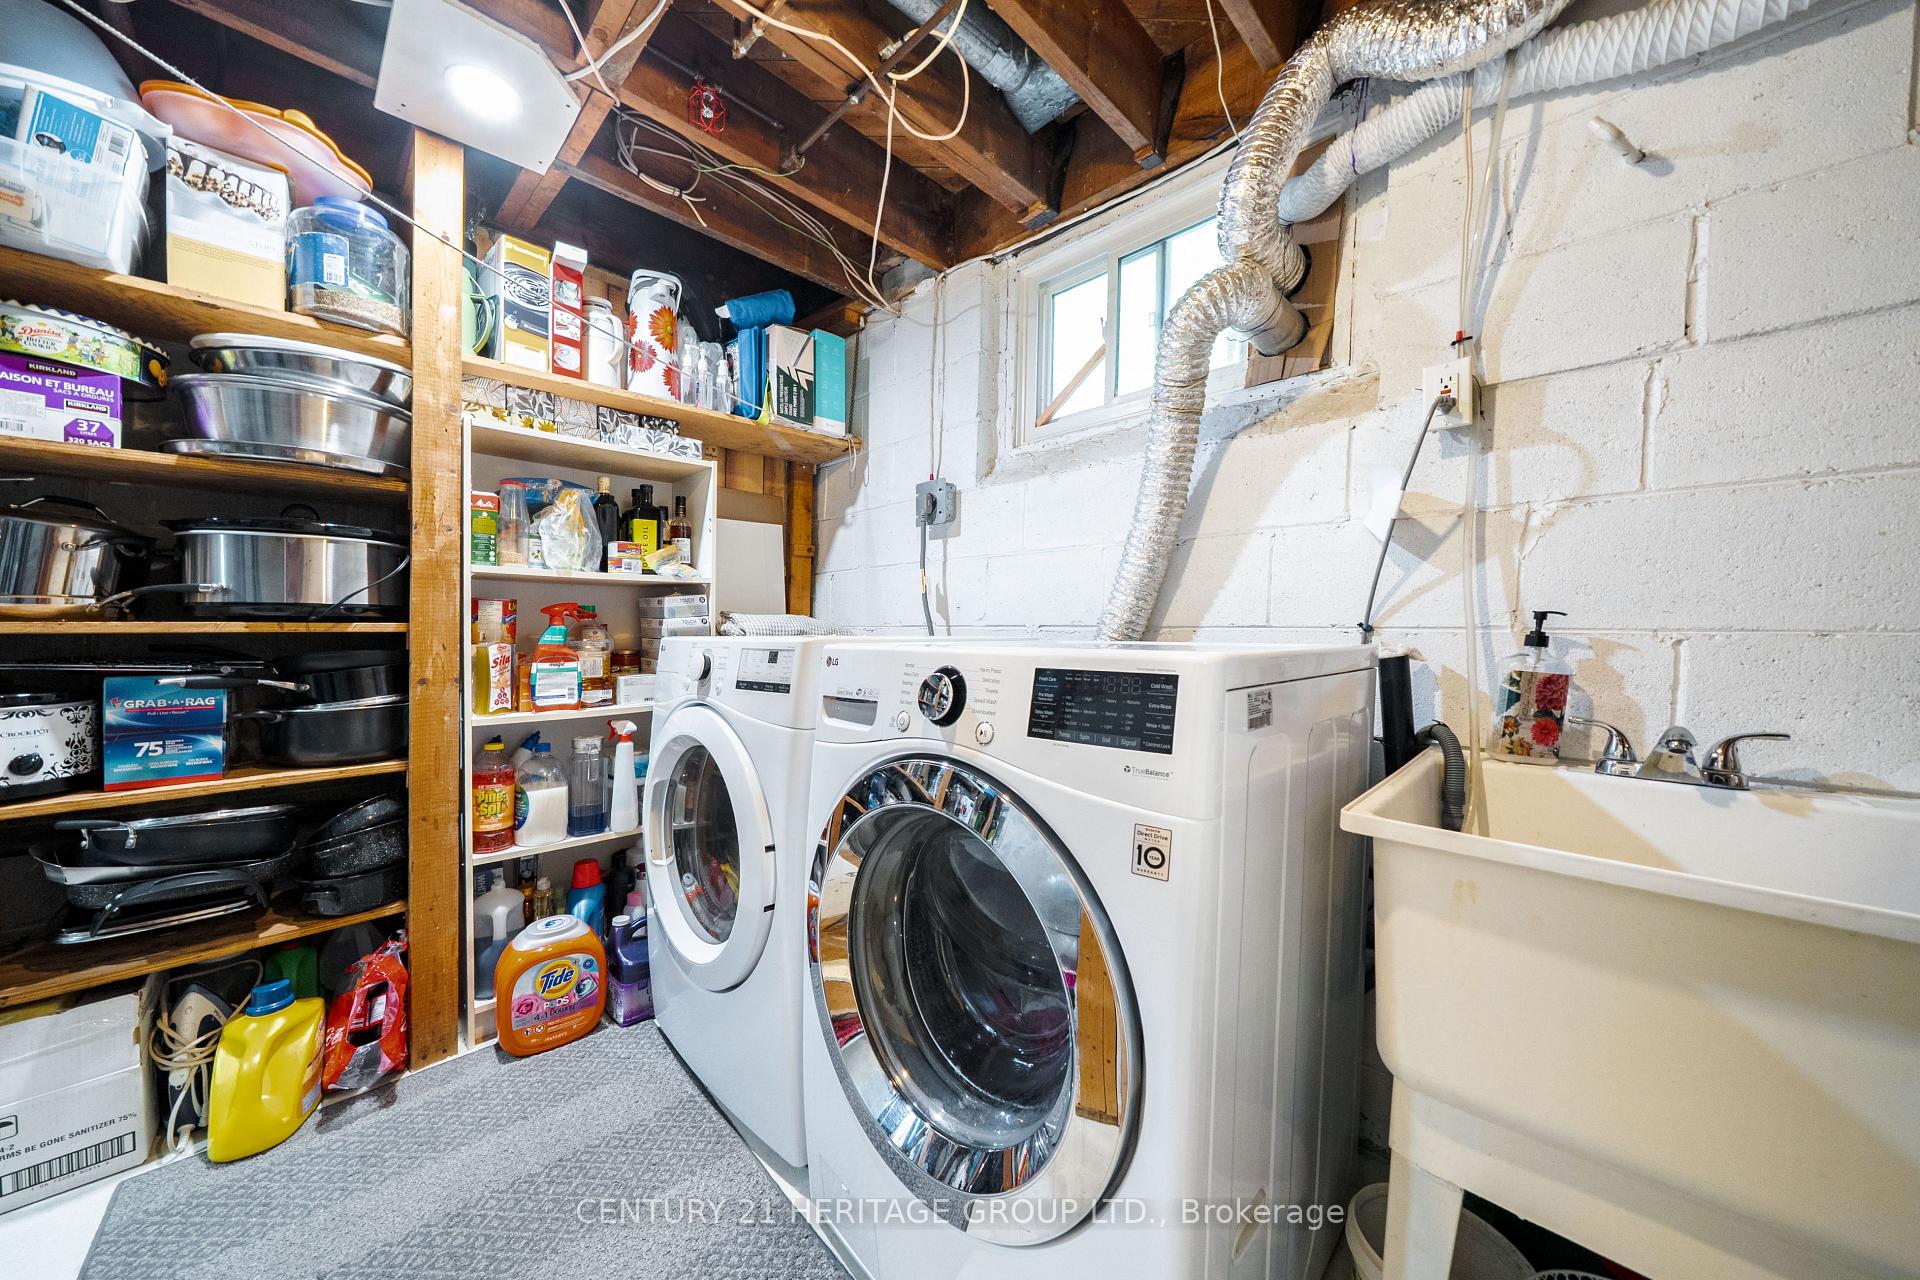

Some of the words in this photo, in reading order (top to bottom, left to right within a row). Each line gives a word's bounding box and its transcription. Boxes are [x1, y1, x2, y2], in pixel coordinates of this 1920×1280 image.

[28, 363, 77, 377] KIRKLAND
[45, 378, 61, 388] ET
[63, 382, 115, 398] BUREAU
[53, 388, 73, 396] SACS
[81, 393, 115, 402] ORDURES
[67, 401, 107, 412] KIRKLAND
[76, 419, 101, 432] 37
[67, 436, 85, 444] 320
[87, 438, 111, 447] SACS
[133, 741, 164, 758] 75
[1121, 738, 1137, 747] Signal
[1137, 829, 1153, 839] Direct
[1153, 833, 1169, 842] Drive
[1136, 843, 1166, 870] 10
[1149, 854, 1160, 862] YEAR
[540, 967, 575, 995] Tide
[543, 996, 570, 1010] PODS
[24, 1143, 37, 1153] BE
[39, 1134, 66, 1149] GONE
[68, 1118, 117, 1140] SANITIZER
[118, 1111, 138, 1123] 75%
